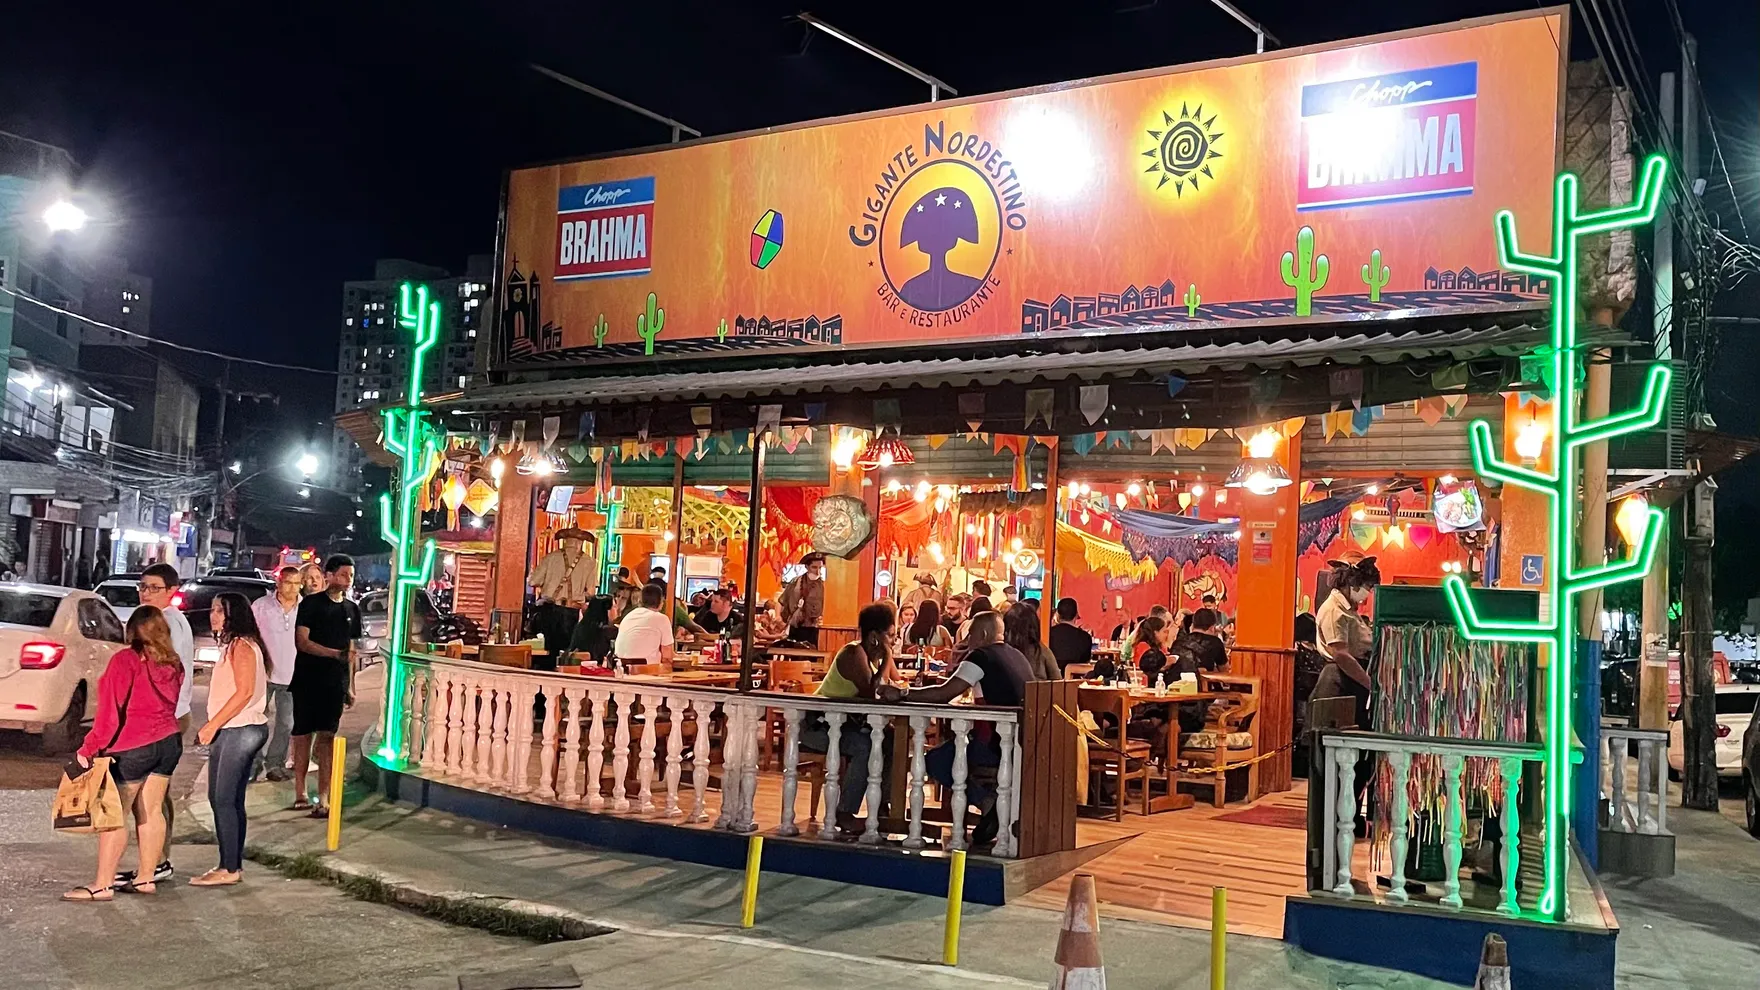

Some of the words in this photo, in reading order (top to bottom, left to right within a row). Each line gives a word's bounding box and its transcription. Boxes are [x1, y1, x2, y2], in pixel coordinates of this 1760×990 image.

[1349, 80, 1433, 103] Chopp
[1307, 113, 1464, 189] BHMA
[584, 186, 631, 206] Chopp
[849, 144, 918, 247] GIGANTE
[924, 120, 1027, 231] NORDESTINO
[560, 213, 646, 266] BRAHMA
[877, 282, 898, 314] BAR
[909, 274, 1001, 328] RESTAURANTE
